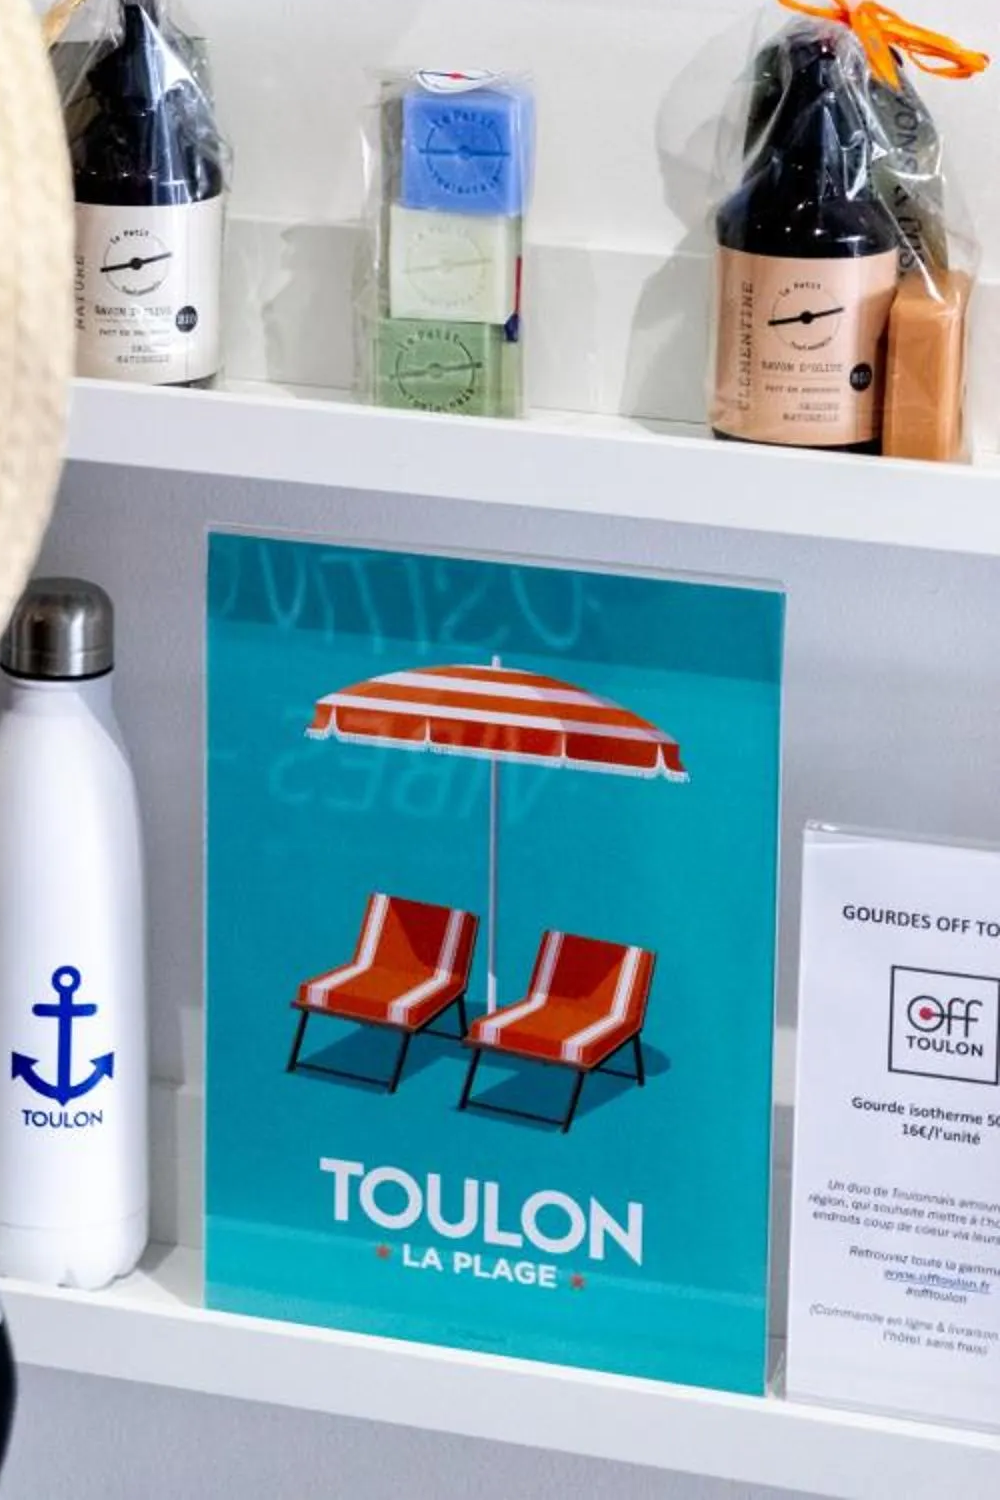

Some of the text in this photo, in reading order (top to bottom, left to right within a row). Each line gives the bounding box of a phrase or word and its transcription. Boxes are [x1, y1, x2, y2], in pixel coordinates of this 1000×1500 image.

[842, 904, 1000, 937] GOURDES OFF TO
[907, 995, 983, 1038] Off
[905, 1035, 983, 1057] TOULON
[21, 1109, 103, 1128] TOULON
[851, 1096, 905, 1115] Gourde
[909, 1103, 983, 1125] isotherme
[828, 1179, 845, 1191] Un
[847, 1182, 870, 1195] duo
[874, 1186, 888, 1197] de
[319, 1156, 643, 1267] TOULON
[403, 1243, 558, 1289] LA PLAGE
[849, 1245, 908, 1264] Retrouvez
